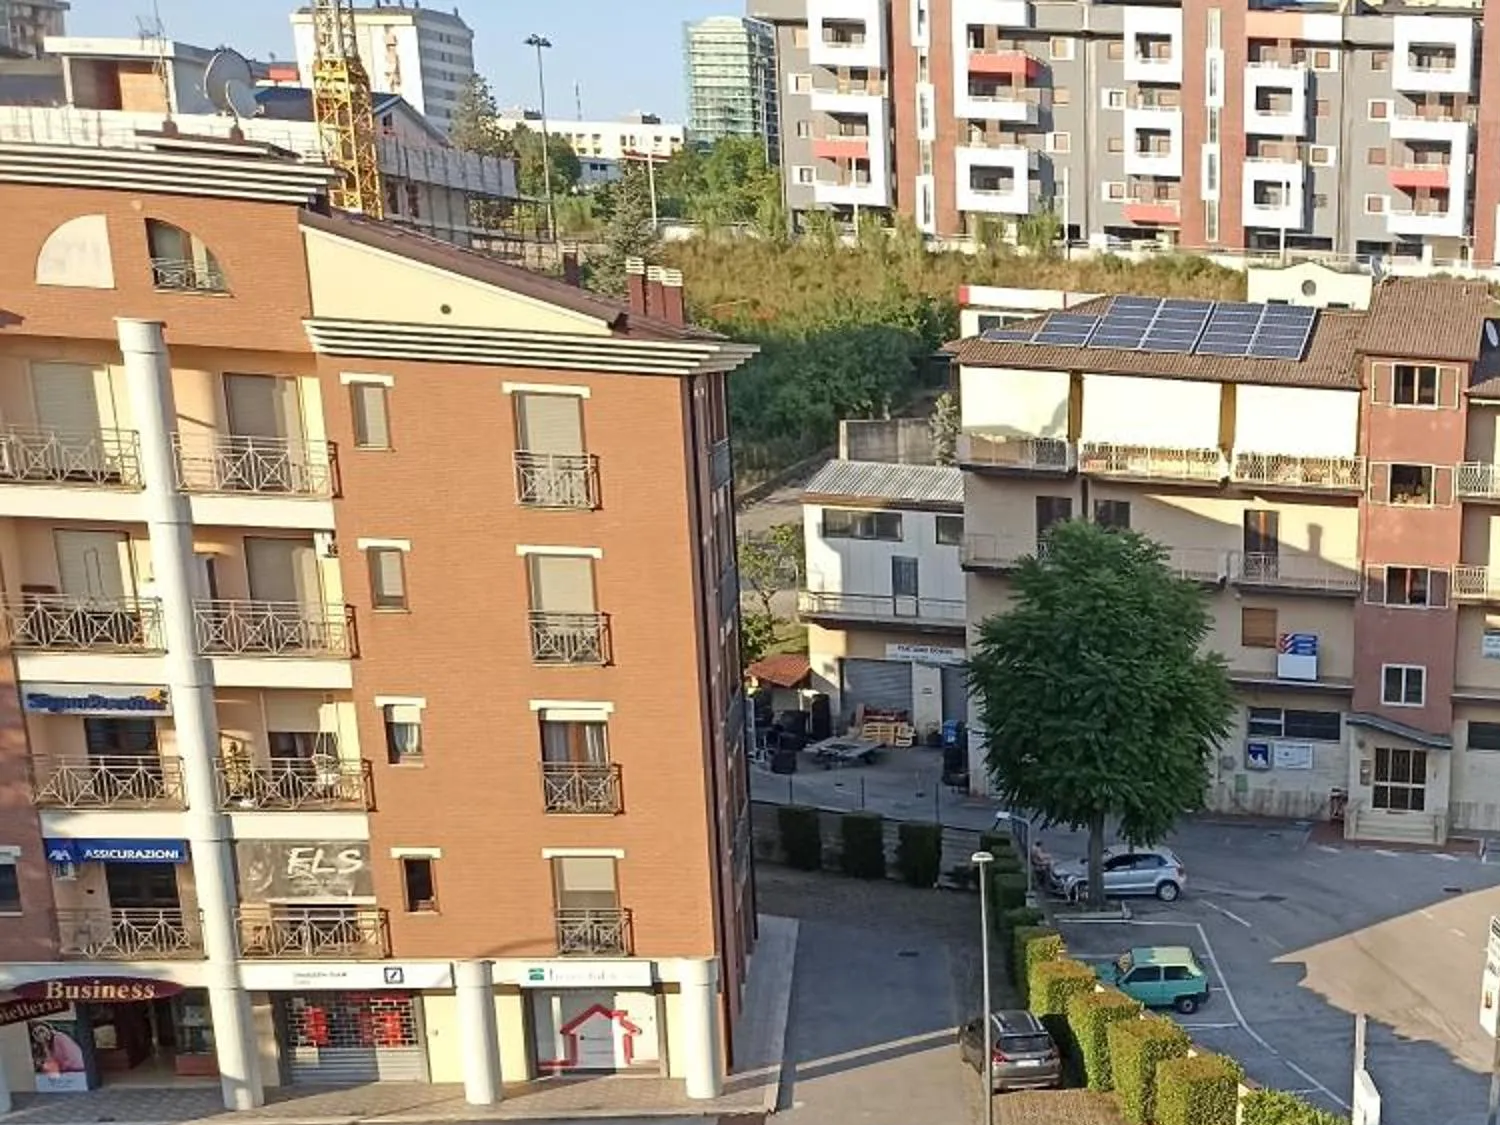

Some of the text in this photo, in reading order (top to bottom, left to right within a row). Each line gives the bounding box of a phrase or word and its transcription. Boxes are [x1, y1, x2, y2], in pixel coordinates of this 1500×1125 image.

[49, 849, 180, 861] AXA ASSICURAZIONI
[46, 981, 156, 1000] Business
